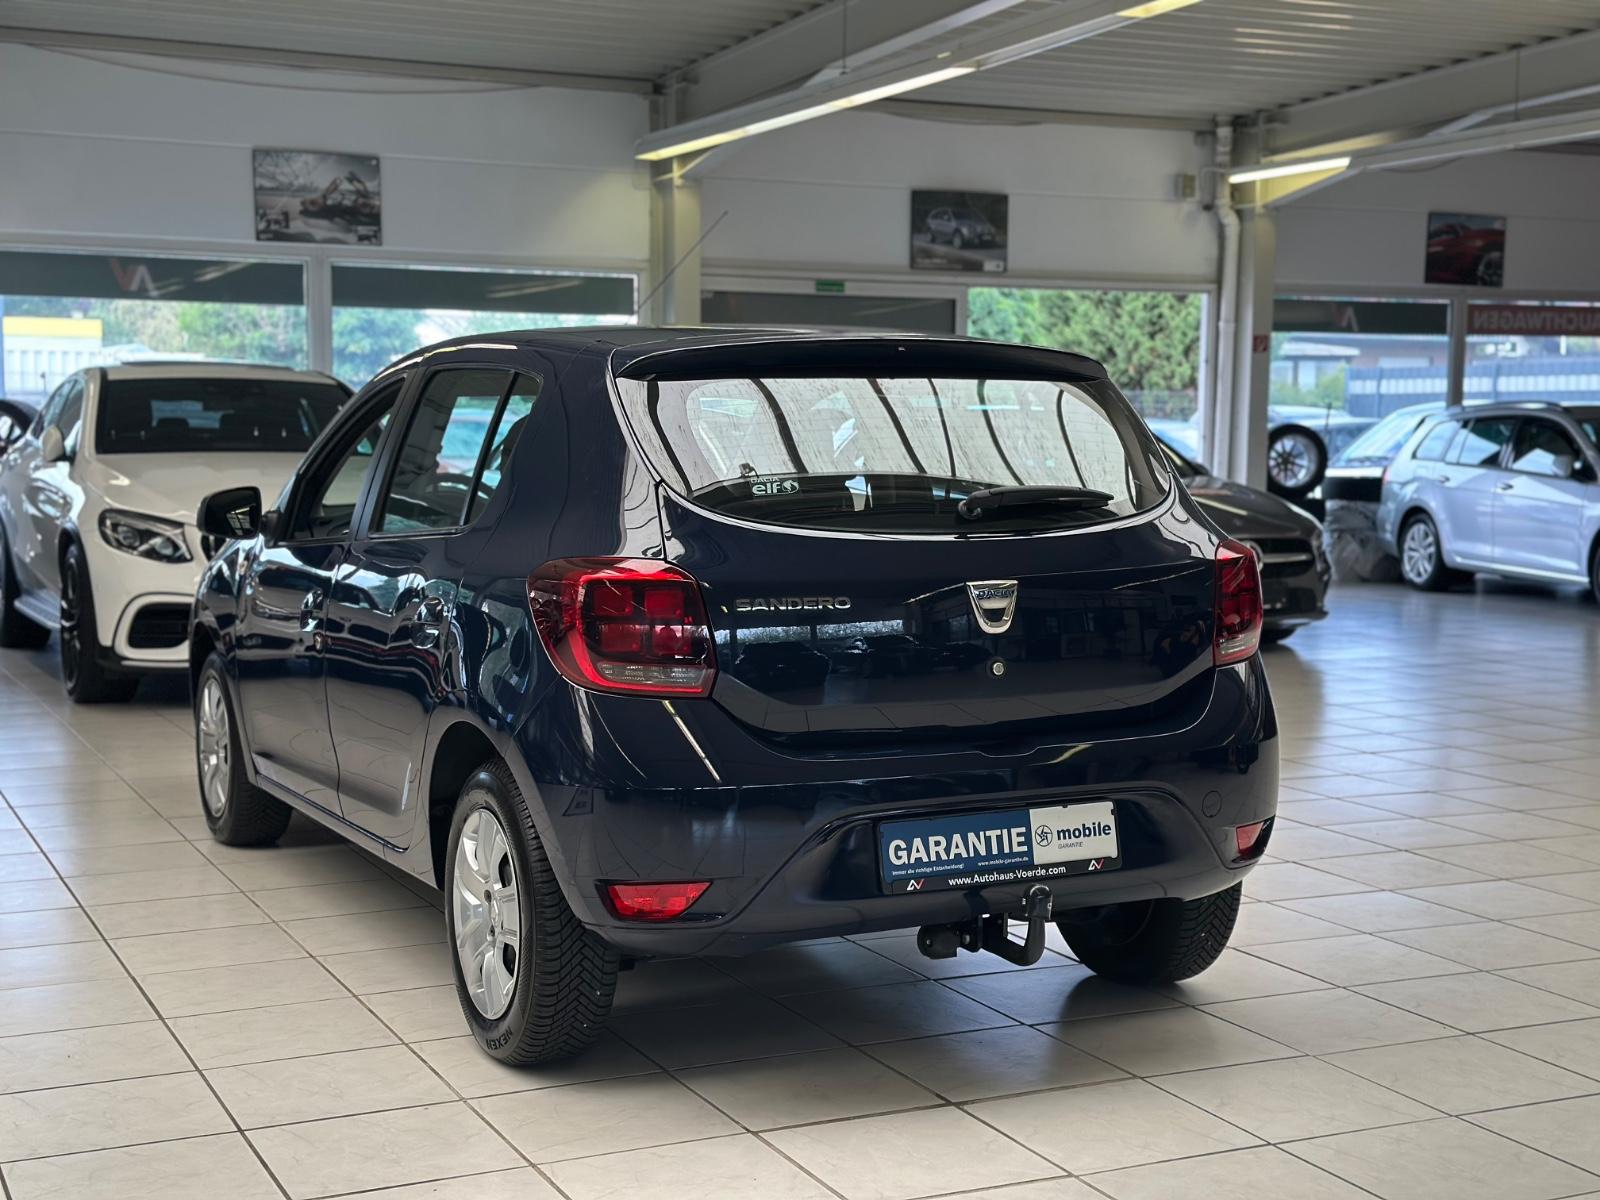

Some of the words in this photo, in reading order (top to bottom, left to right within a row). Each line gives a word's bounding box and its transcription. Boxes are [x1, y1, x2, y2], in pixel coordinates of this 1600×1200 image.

[752, 482, 781, 495] elf
[735, 597, 851, 611] SANDERO
[1056, 821, 1112, 841] mobile
[888, 827, 1029, 866] GARANTIE
[1057, 841, 1084, 850] GARANTIE
[948, 866, 1067, 886] www.Autohaus-Voerde.com
[485, 1025, 513, 1050] NEXEN
